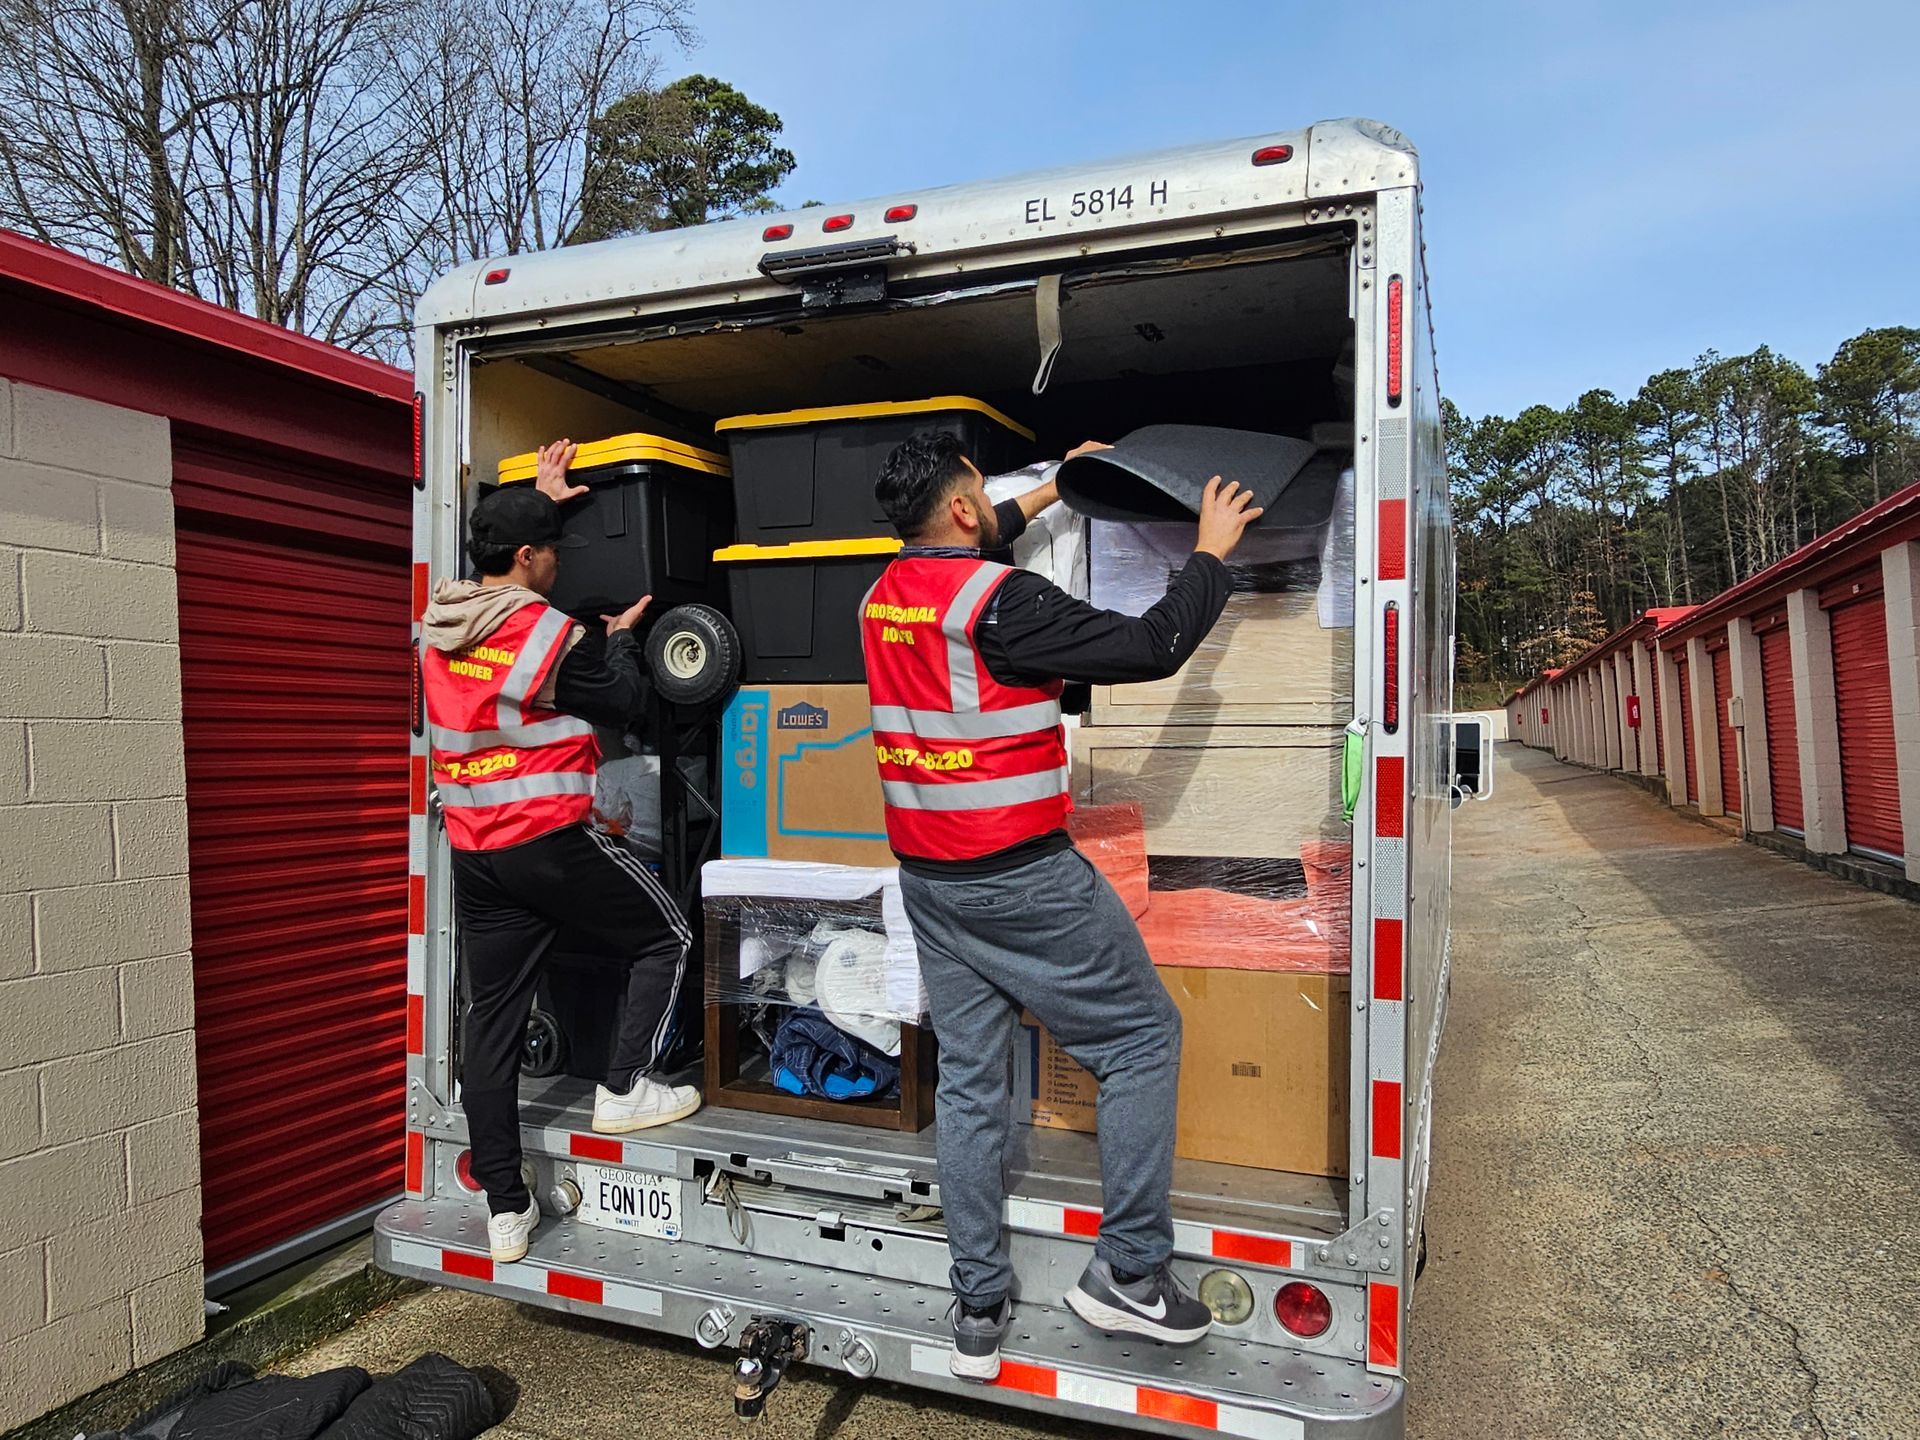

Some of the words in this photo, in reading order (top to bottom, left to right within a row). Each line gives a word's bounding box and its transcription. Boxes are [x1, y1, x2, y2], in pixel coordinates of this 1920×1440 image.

[1025, 197, 1056, 224] EL
[1070, 184, 1134, 217] 5814
[1150, 179, 1168, 206] H
[448, 658, 493, 681] MOVER
[736, 703, 765, 789] large
[1053, 1080, 1079, 1090] Laundry
[599, 1167, 658, 1186] GEORGIA
[600, 1181, 672, 1220] EQN105
